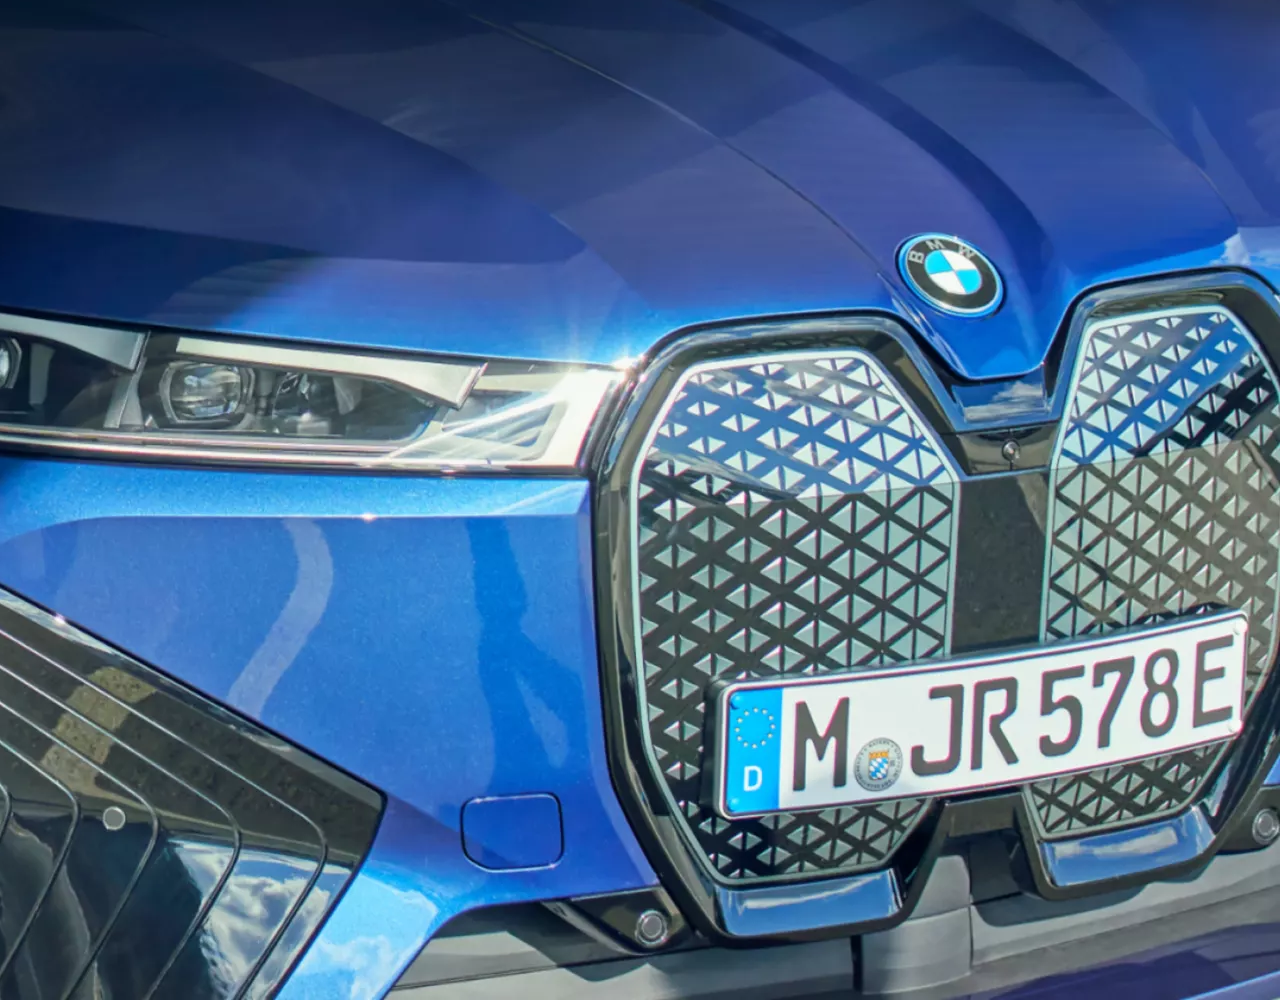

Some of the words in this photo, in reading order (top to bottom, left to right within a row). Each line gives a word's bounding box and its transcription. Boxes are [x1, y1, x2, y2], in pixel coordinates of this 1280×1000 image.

[908, 240, 975, 264] BMW
[793, 697, 850, 792] M
[911, 675, 1019, 776] JR
[1039, 634, 1234, 757] 578E
[743, 765, 763, 792] D
